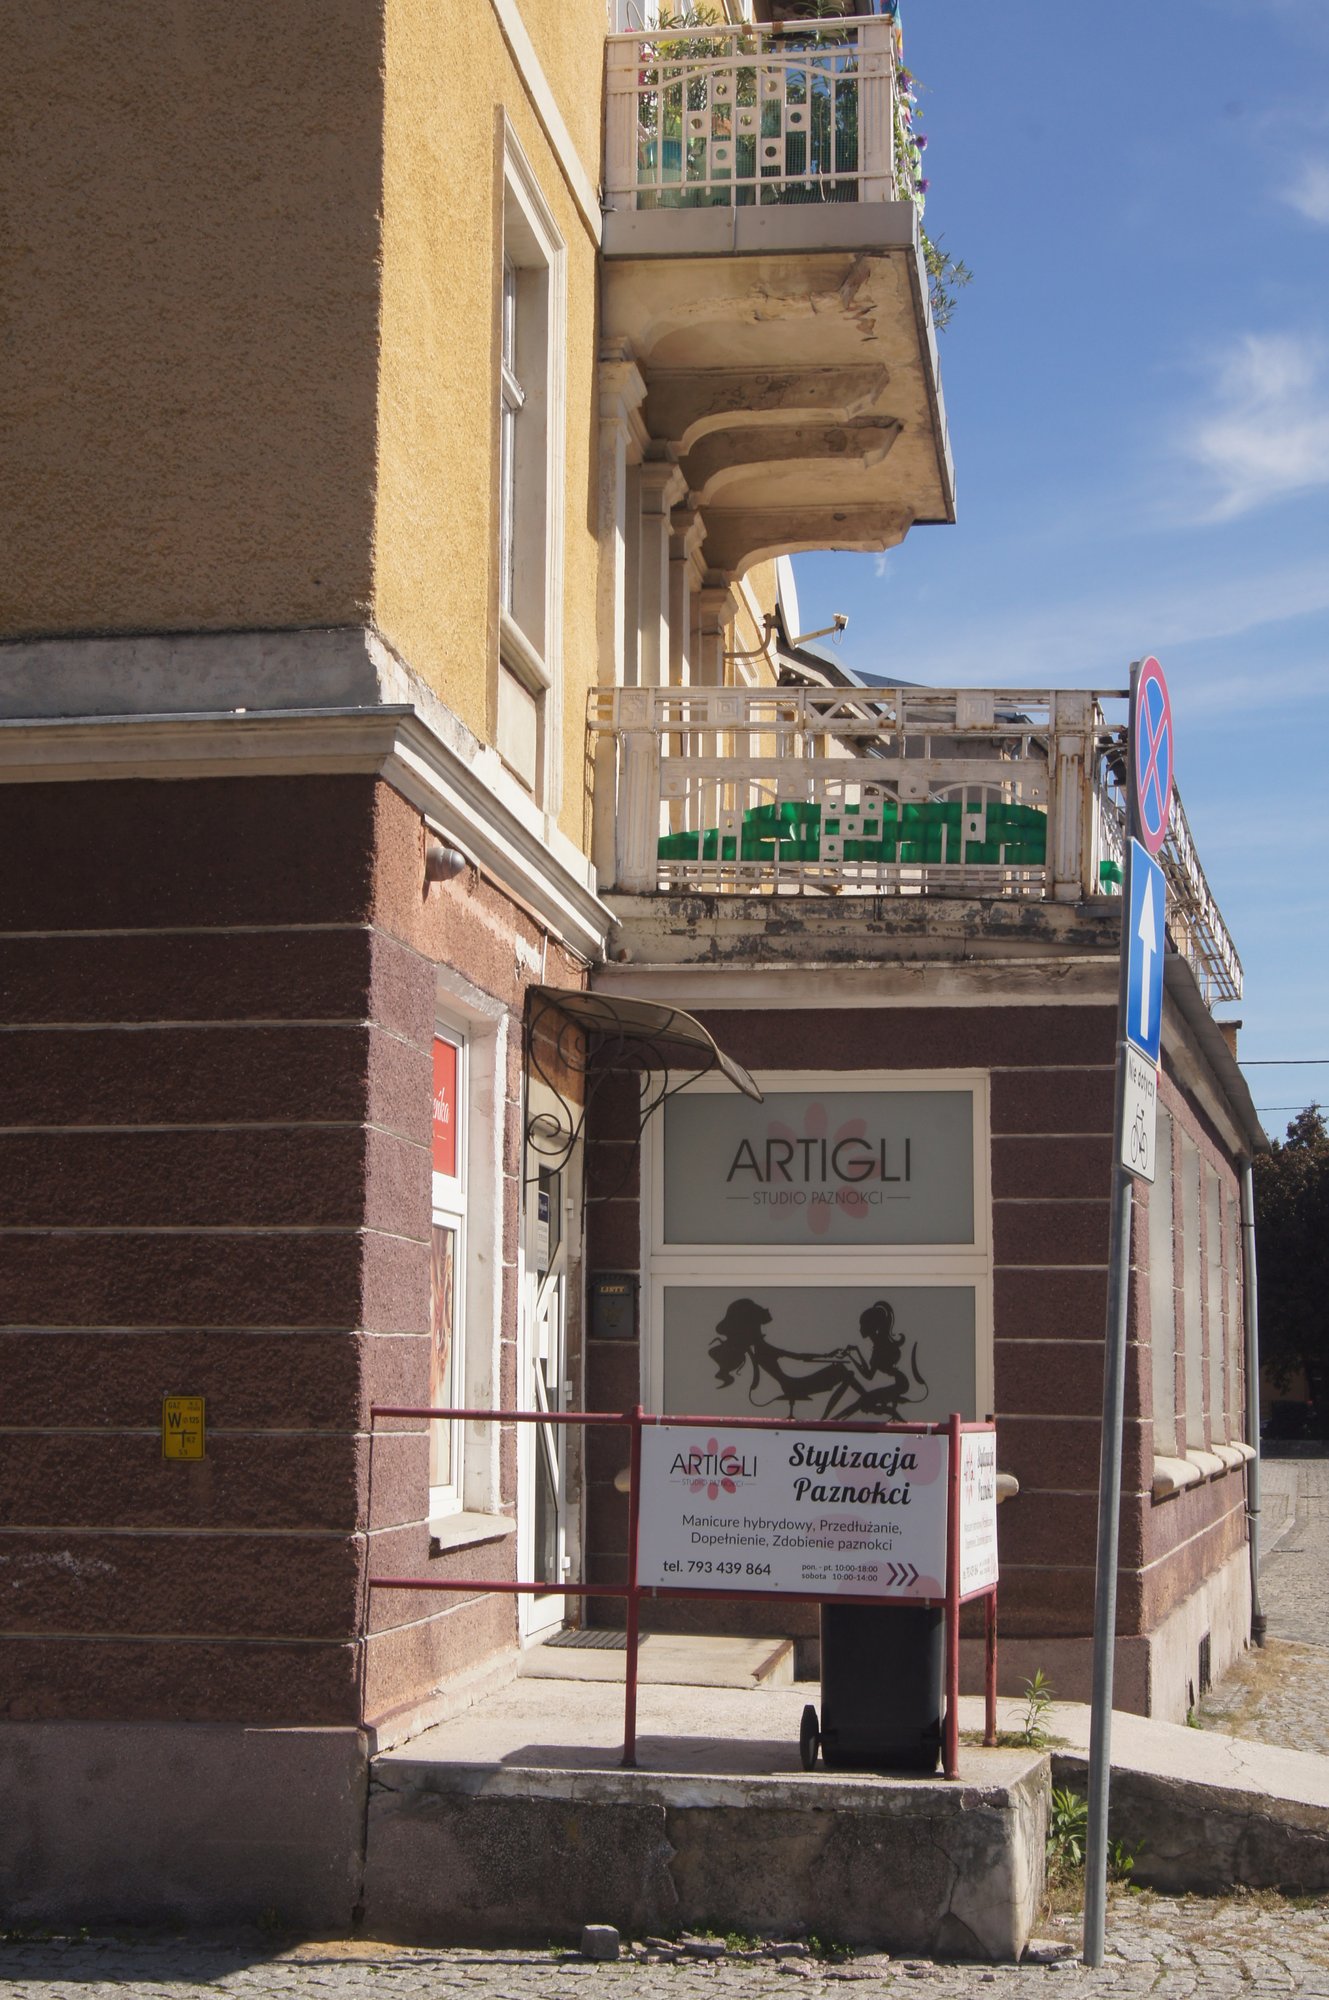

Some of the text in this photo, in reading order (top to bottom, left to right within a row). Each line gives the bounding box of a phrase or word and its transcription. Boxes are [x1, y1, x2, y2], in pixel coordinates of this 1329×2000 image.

[1128, 1054, 1155, 1107] Nie dotyczy
[726, 1138, 911, 1182] ARTIGLI
[753, 1191, 883, 1205] STUDIO PAZNOKCI
[168, 1412, 182, 1429] W
[669, 1453, 757, 1477] ARTIGLI
[788, 1442, 918, 1477] Stylizacja
[793, 1477, 912, 1505] Paznokci
[682, 1514, 902, 1536] Manicure hybrydowy, Przedłużanie,
[691, 1531, 892, 1551] Dopełnienie, Zdobienie paznokci
[663, 1560, 771, 1576] tel. 793 439 864
[833, 1573, 878, 1581] 10:00-14:00
